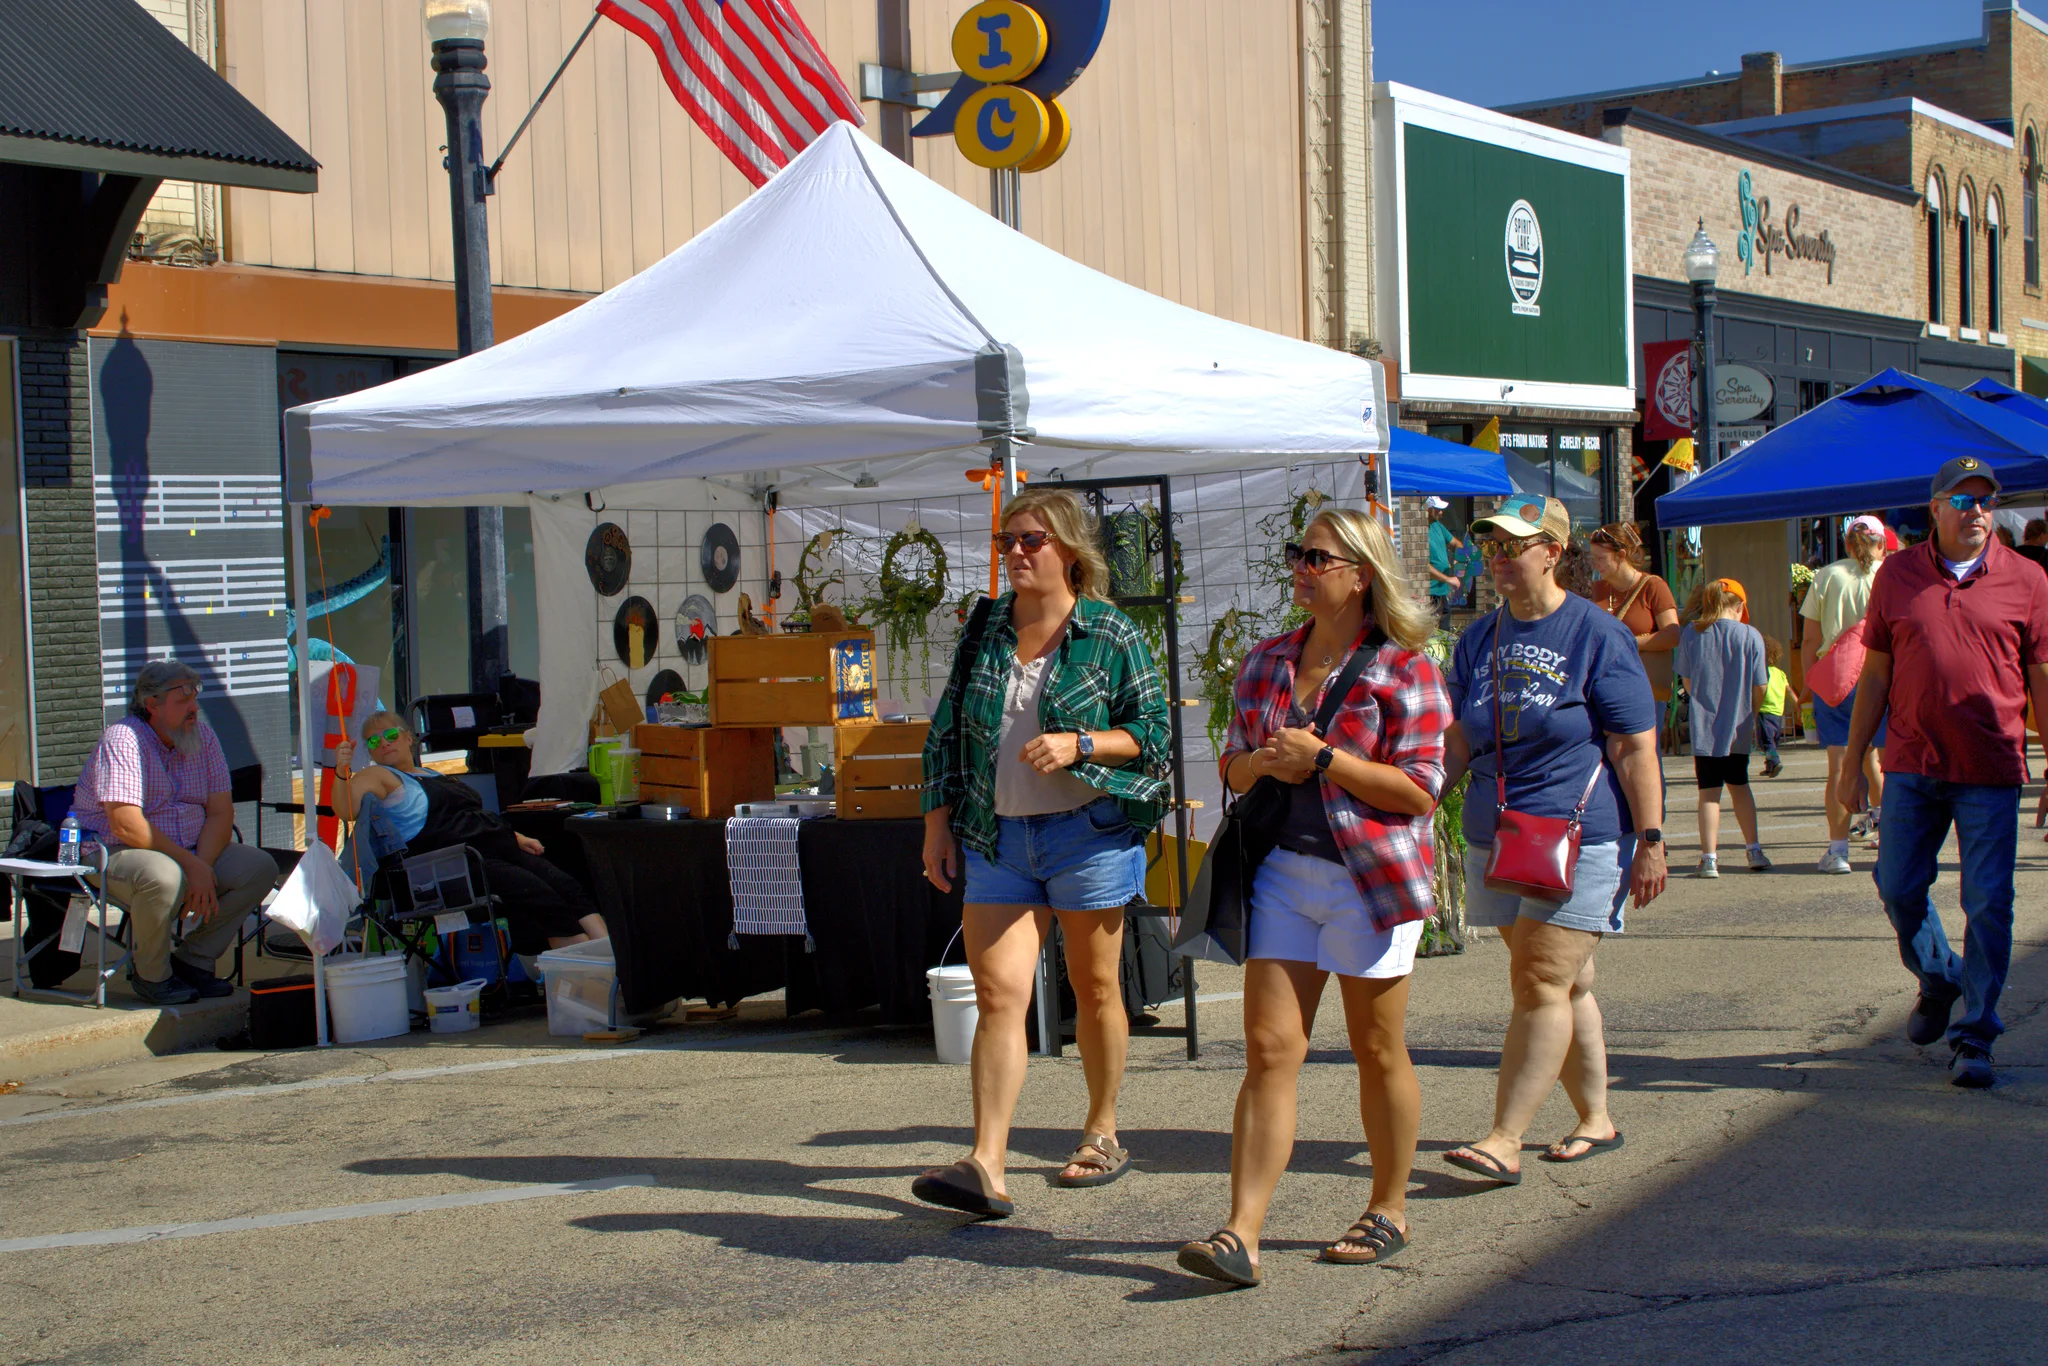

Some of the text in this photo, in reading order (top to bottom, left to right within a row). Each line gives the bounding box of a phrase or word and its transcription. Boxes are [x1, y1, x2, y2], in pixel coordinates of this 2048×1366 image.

[1514, 218, 1531, 234] SPIRIT
[1755, 195, 1785, 276] Spa
[1517, 235, 1530, 250] LAKE
[1726, 377, 1752, 395] Spa
[1715, 388, 1765, 409] Serenity
[1528, 434, 1548, 449] NATURE
[1719, 429, 1762, 439] outique
[1667, 457, 1692, 471] OPEN
[1511, 643, 1566, 667] BODY
[861, 642, 872, 714] BLUE BIRD
[1474, 664, 1489, 680] IS
[1502, 656, 1570, 687] TEMPLE
[1520, 681, 1557, 712] Bar
